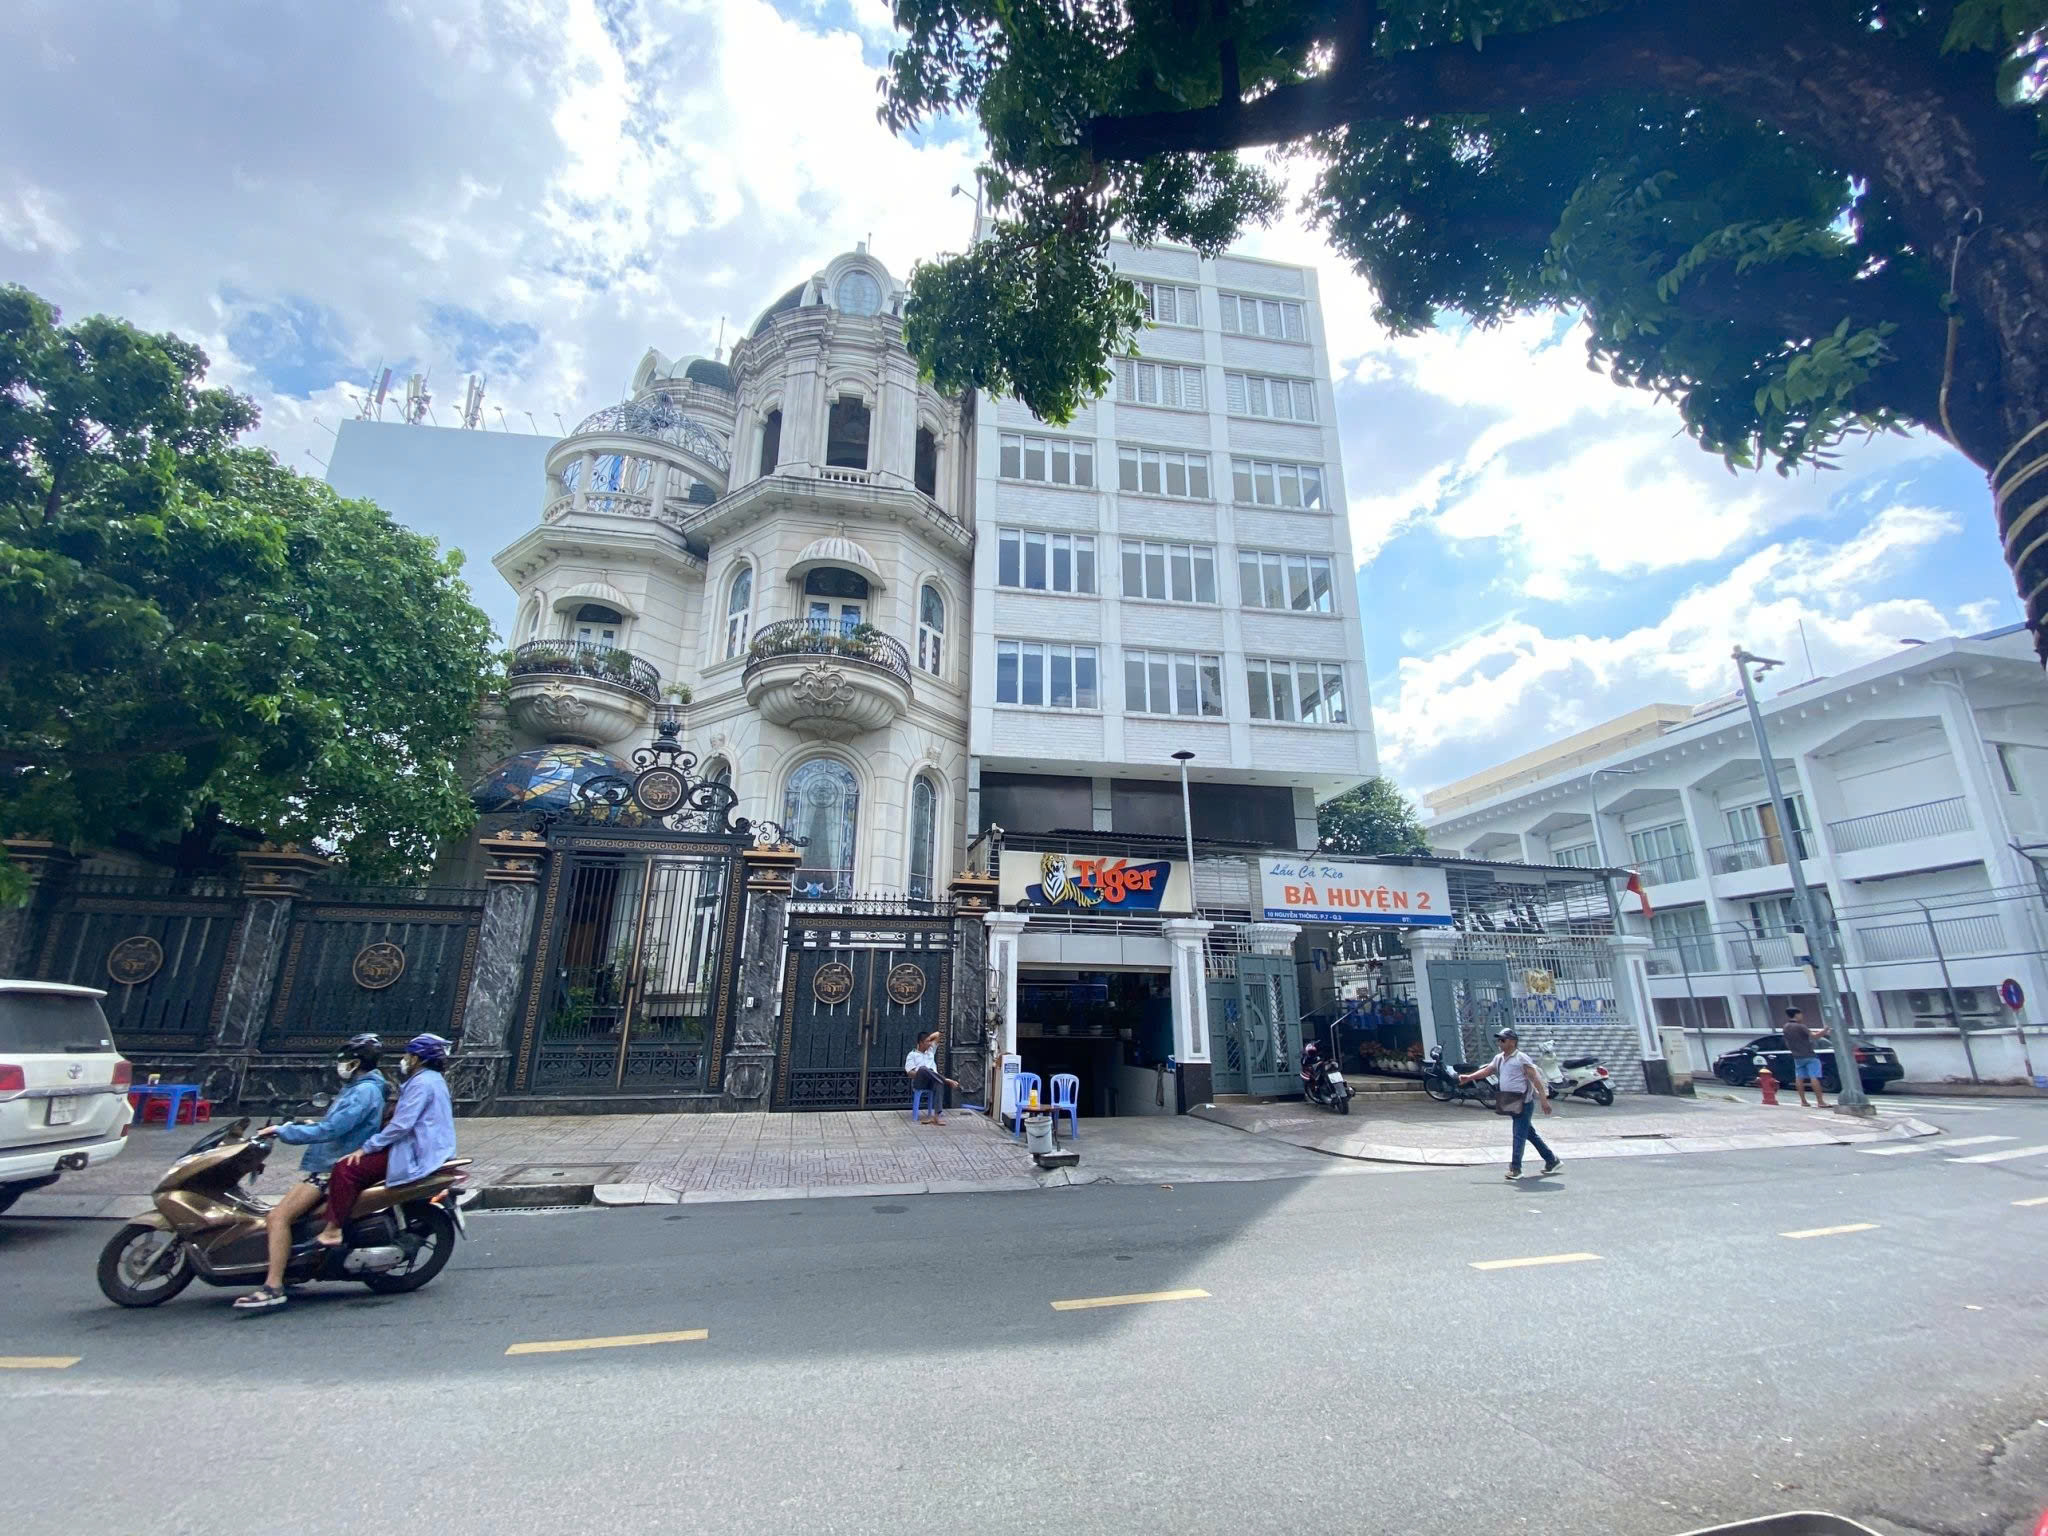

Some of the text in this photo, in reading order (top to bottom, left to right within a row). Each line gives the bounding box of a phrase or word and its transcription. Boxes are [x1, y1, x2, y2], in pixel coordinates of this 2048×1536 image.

[1072, 857, 1158, 903] Tiger
[1284, 882, 1431, 912] BÀ HUYỆN 2
